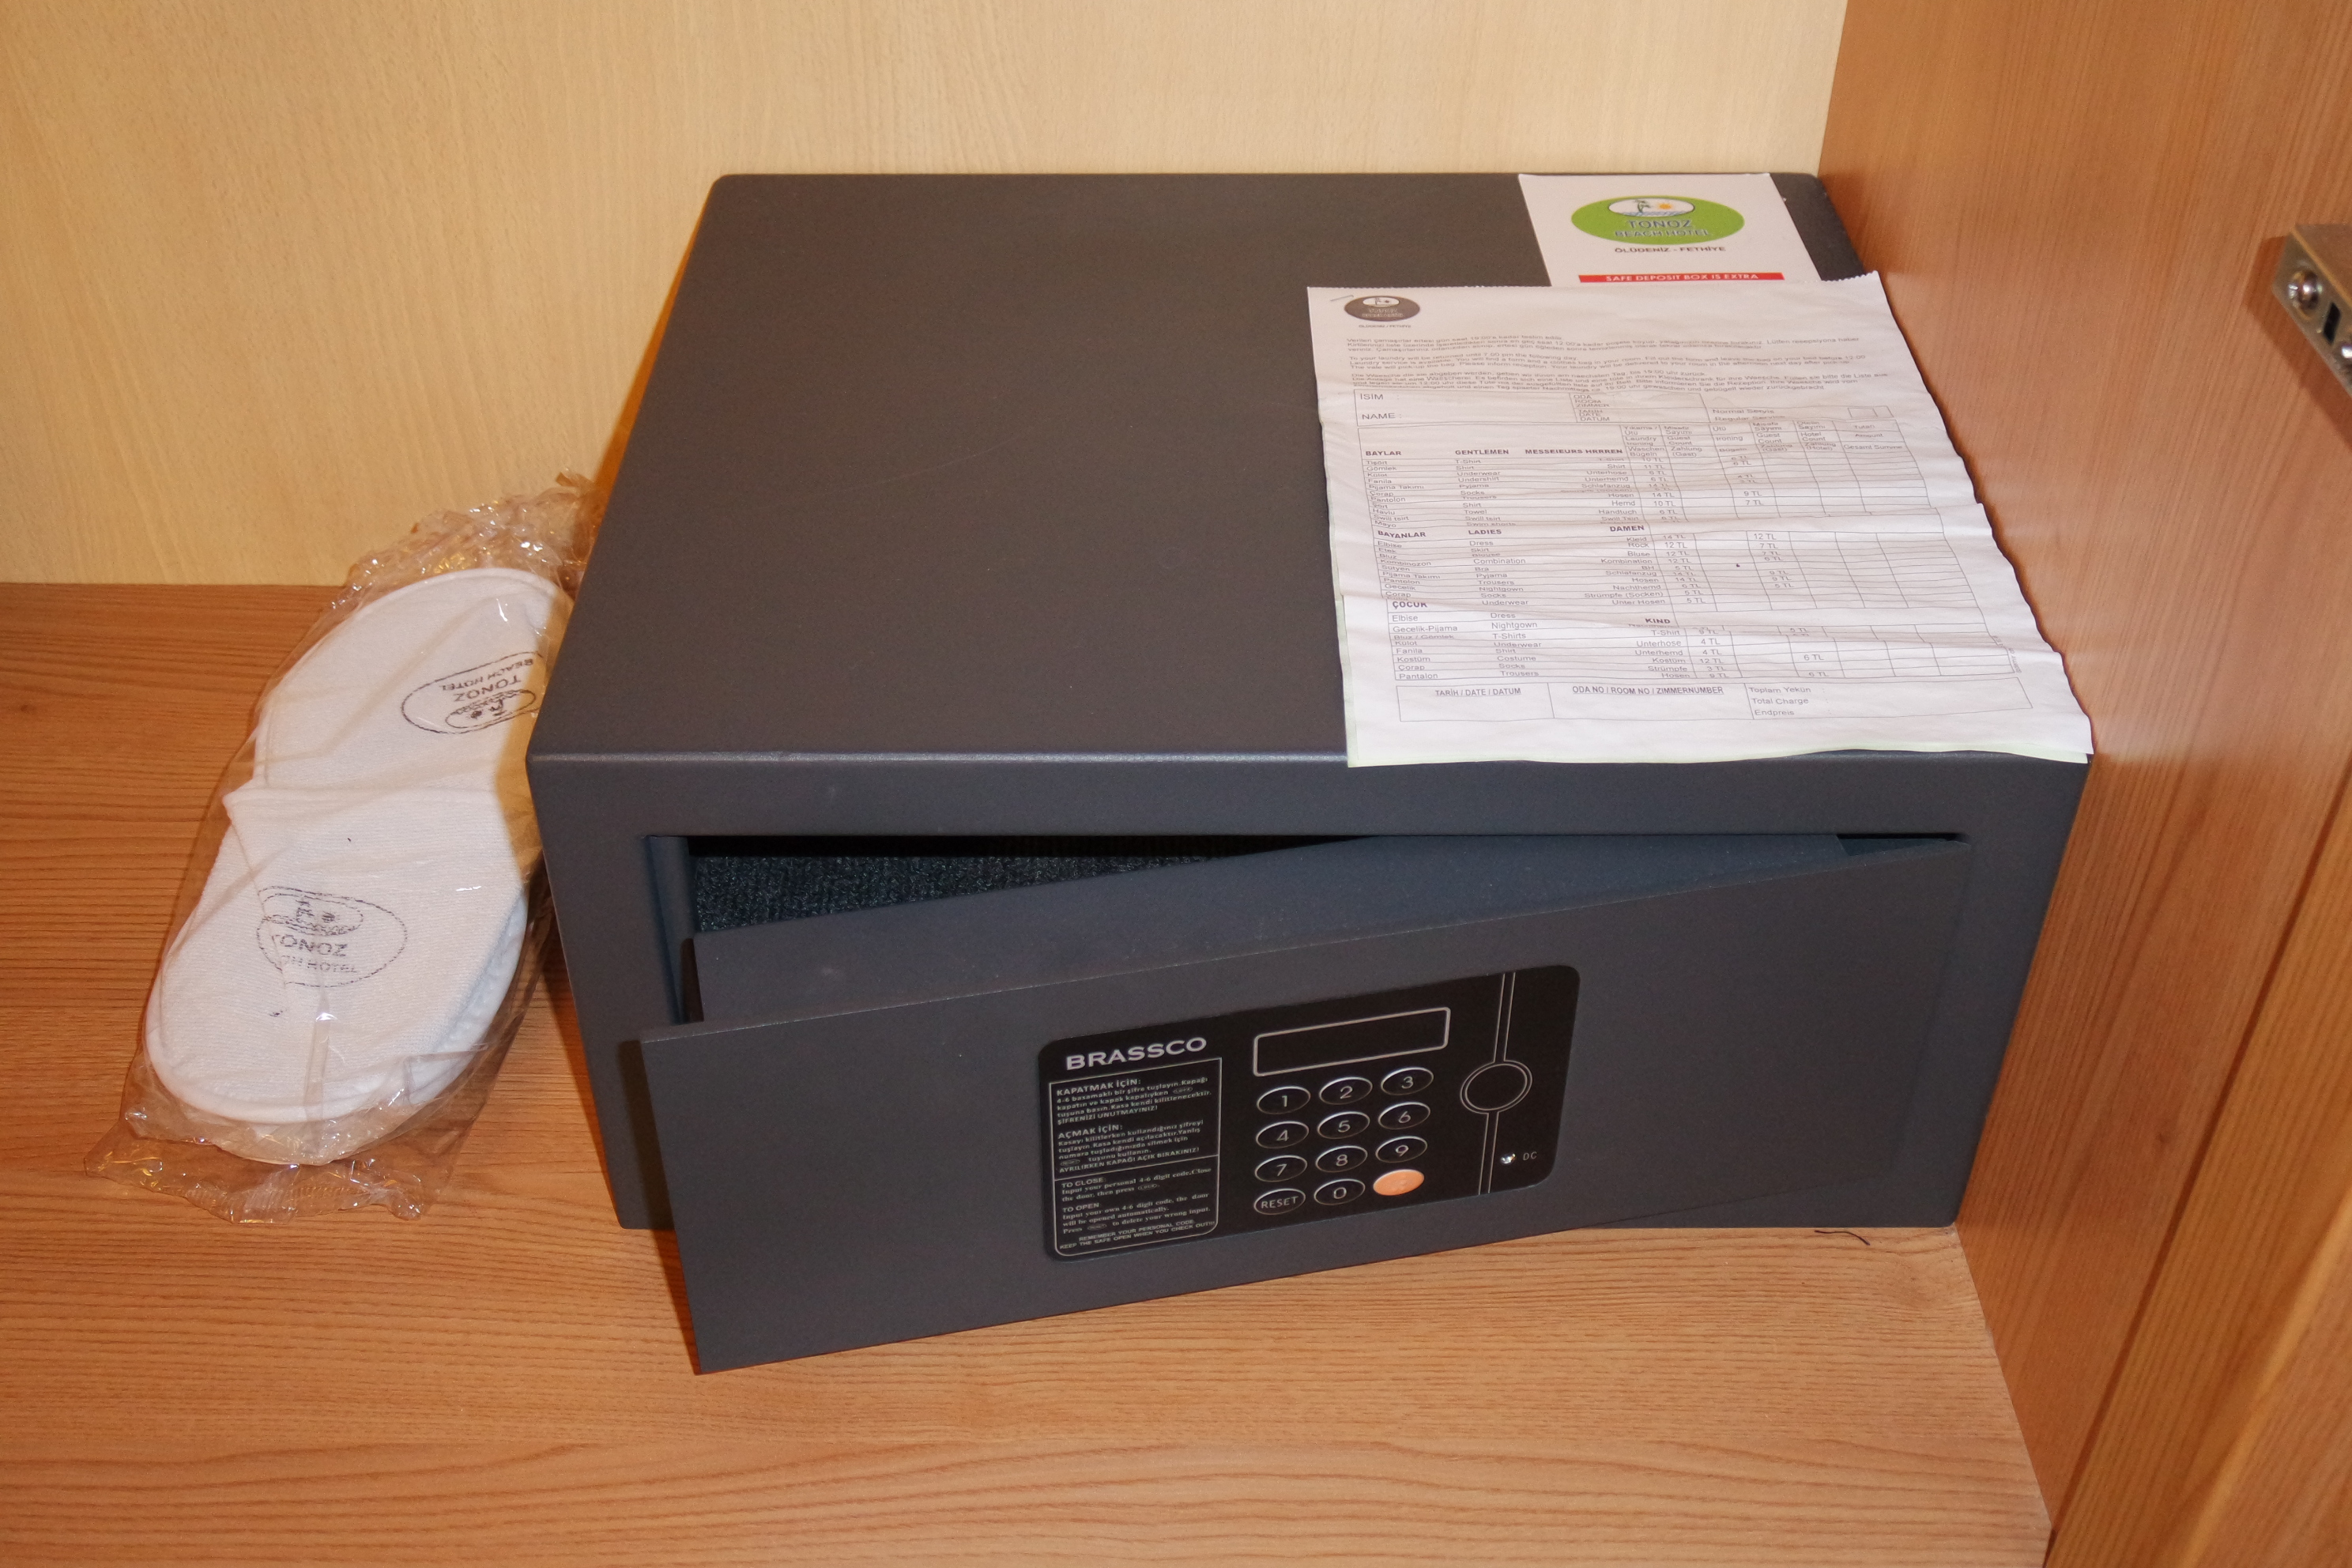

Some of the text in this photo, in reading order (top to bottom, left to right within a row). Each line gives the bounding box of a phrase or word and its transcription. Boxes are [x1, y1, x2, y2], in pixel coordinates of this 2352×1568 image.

[1629, 219, 1692, 228] TONOZ
[439, 676, 483, 691] HOTEL
[453, 674, 522, 702] TONOZ
[1066, 1037, 1207, 1071] BRASSCO
[1057, 1082, 1114, 1096] KAPATMAK
[1281, 1076, 1414, 1107] 1 2 3
[1058, 1127, 1096, 1139] AÇMAK
[1276, 1110, 1412, 1141] 4 5 6
[1276, 1144, 1409, 1176] 7 8 9
[1522, 1151, 1537, 1161] DC
[1104, 1178, 1136, 1189] personal
[1261, 1196, 1299, 1209] RESET
[1079, 1231, 1116, 1242] REMEMBER
[1138, 1223, 1174, 1231] PERSONAL
